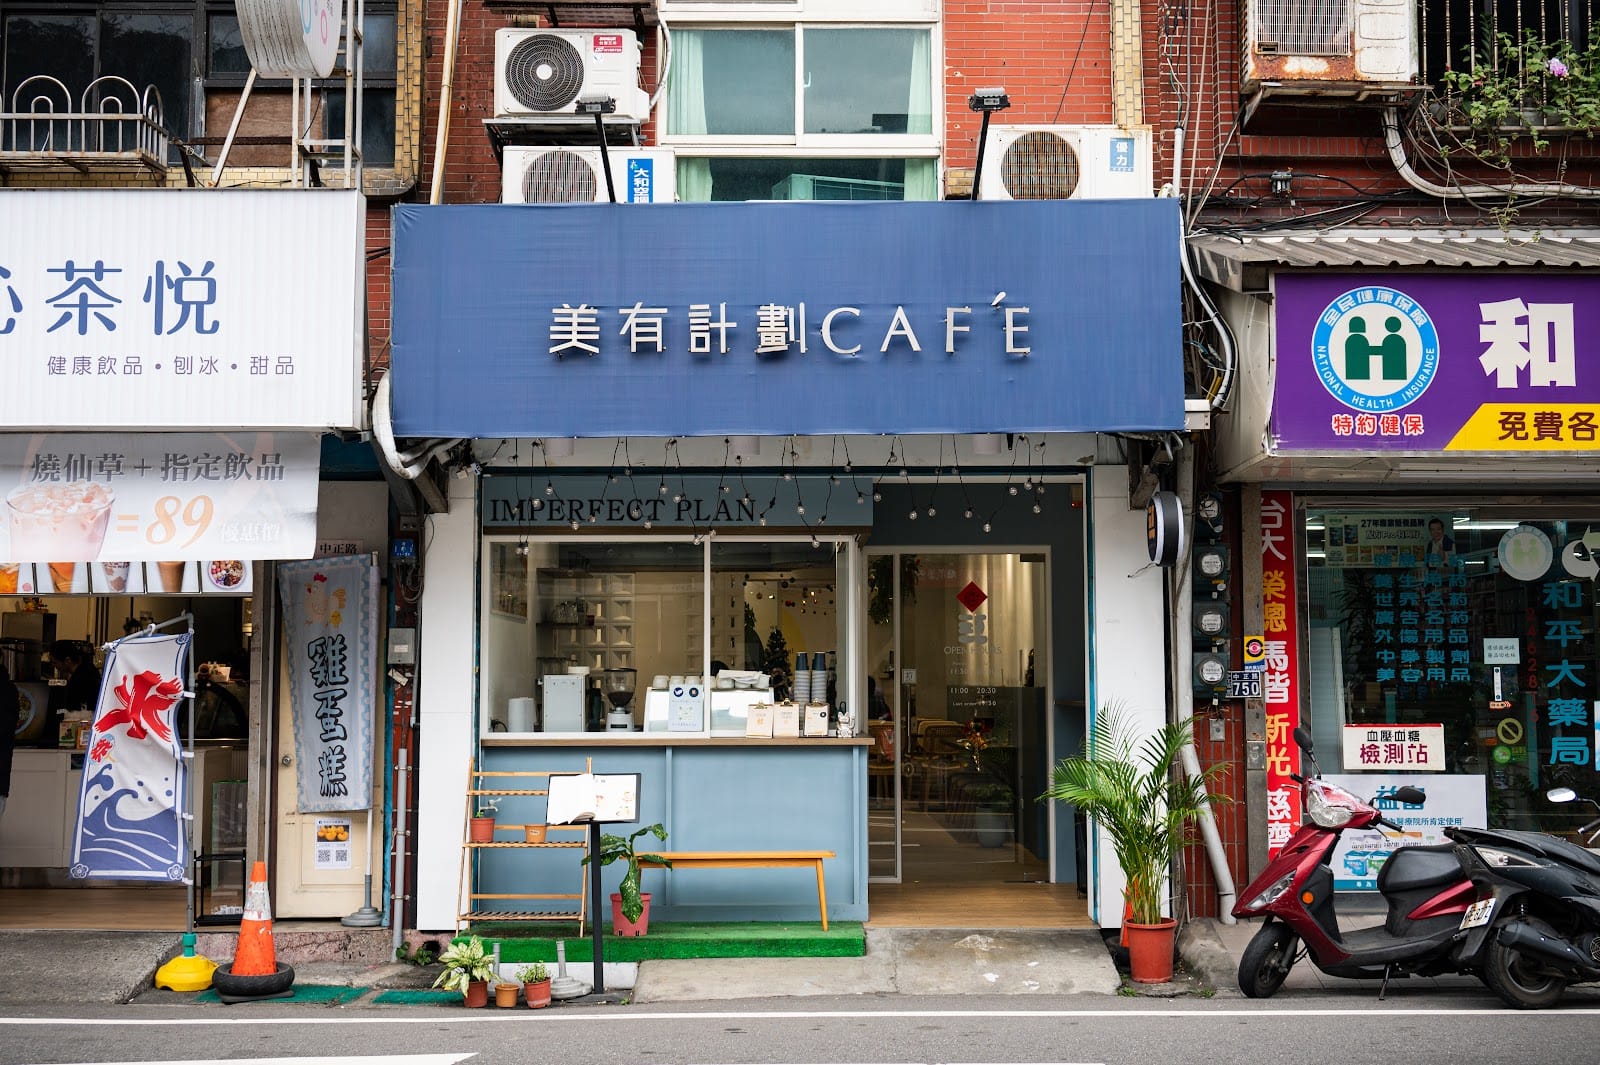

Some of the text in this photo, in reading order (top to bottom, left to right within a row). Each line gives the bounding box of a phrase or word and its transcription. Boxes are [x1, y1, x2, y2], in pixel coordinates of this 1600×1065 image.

[1323, 289, 1428, 327] 全民健康保險
[548, 291, 1032, 355] 美有計劃 CAFÉ
[1478, 297, 1577, 389] 和
[1316, 344, 1435, 409] NATIONAL HEALTH INSURANCE
[1332, 414, 1424, 436] 特約健保
[1497, 411, 1600, 442] 免費各
[489, 498, 756, 522] IMPERFECT PLAN
[319, 542, 358, 555] 中正路
[1376, 667, 1471, 683] 美容用品
[1543, 582, 1590, 765] 和平大藥局
[1233, 682, 1259, 696] 750
[307, 633, 349, 798] 雞蛋糕
[1366, 729, 1421, 743] 血壓血糖
[1359, 743, 1429, 765] 檢測站
